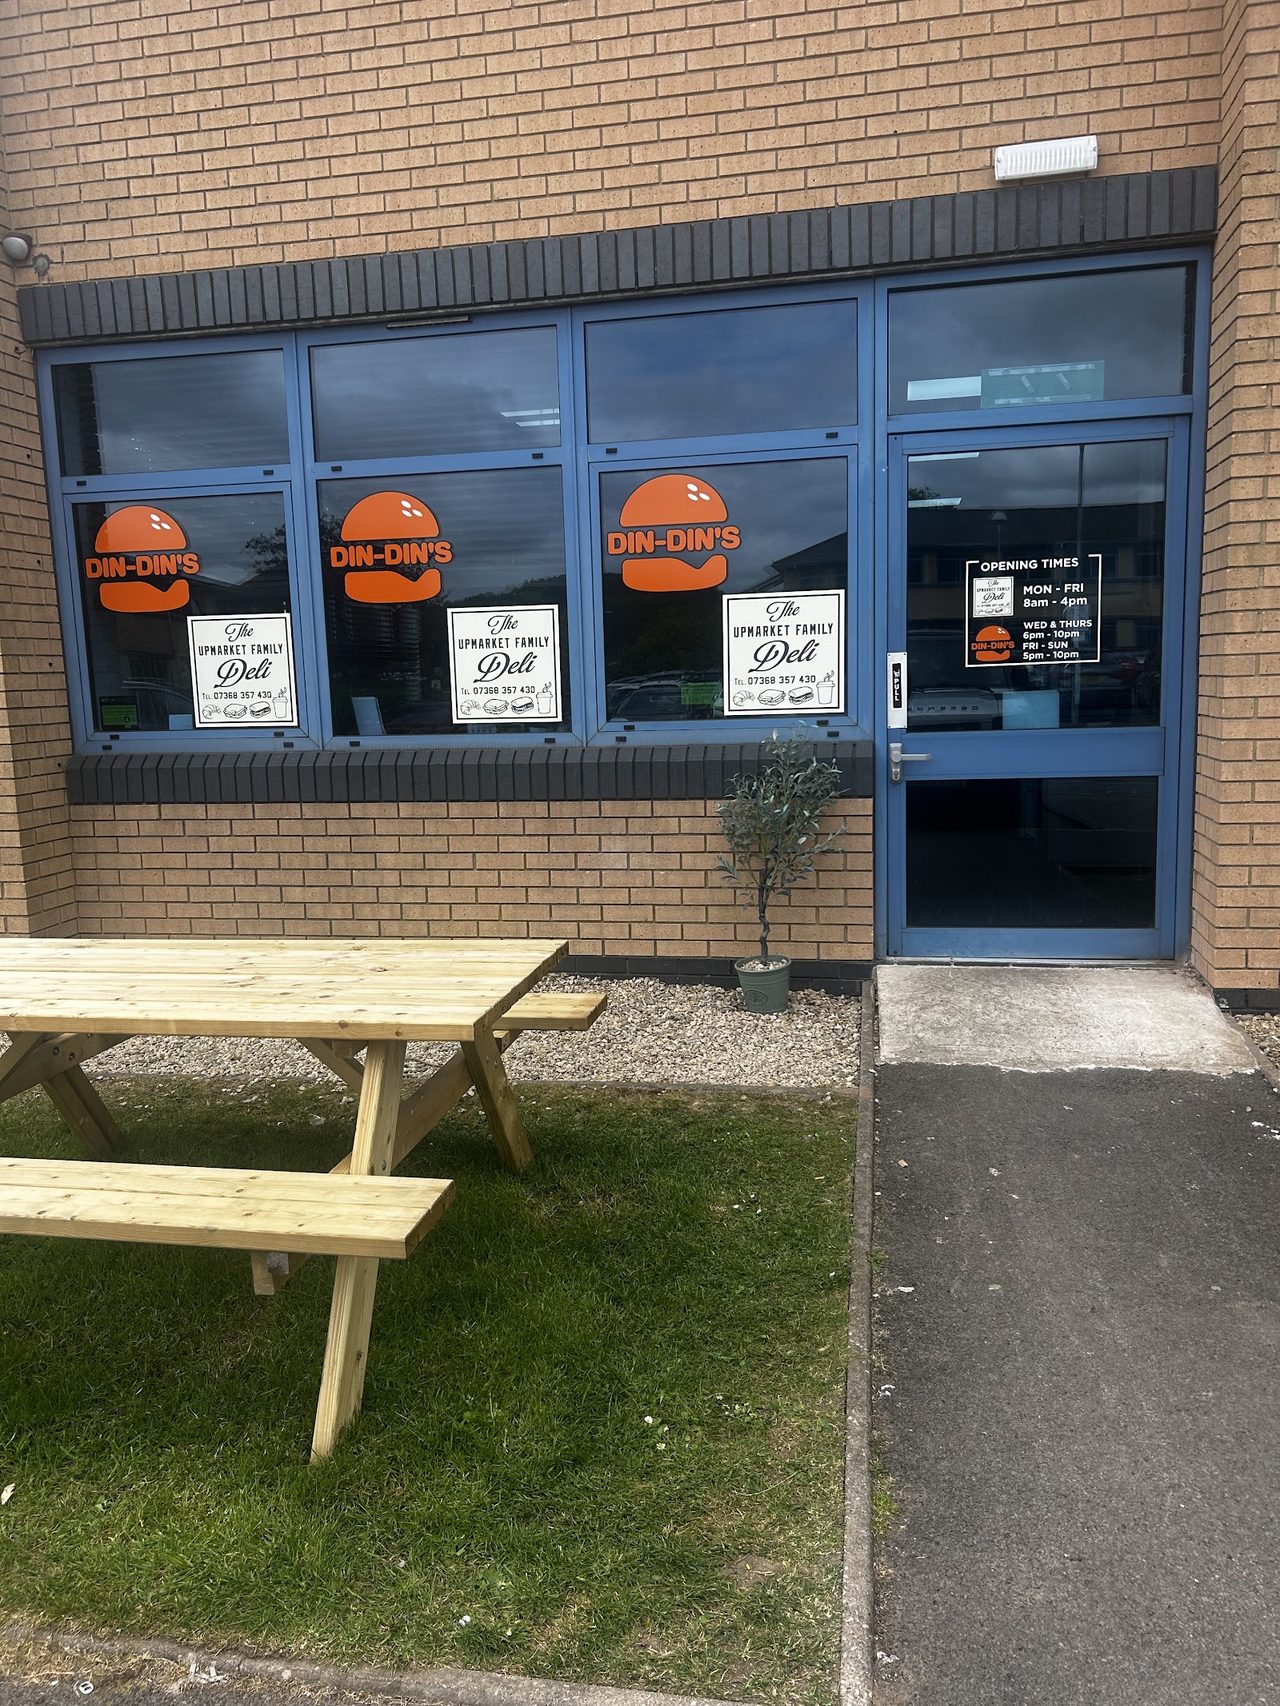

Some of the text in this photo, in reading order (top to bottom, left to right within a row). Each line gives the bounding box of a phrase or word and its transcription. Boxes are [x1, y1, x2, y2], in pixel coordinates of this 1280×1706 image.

[607, 526, 740, 555] DIN-DIN'S
[330, 541, 452, 567] DIN-DIN'S
[85, 553, 199, 578] DIN-DIN'S
[981, 558, 1078, 571] OPENING TIMES
[1024, 585, 1052, 595] MON
[1065, 583, 1083, 593] FRI
[981, 592, 1005, 603] Deli
[1024, 599, 1048, 607] 8am
[1060, 597, 1087, 607] 4pm
[766, 601, 800, 622] The
[488, 615, 518, 635] The
[734, 623, 833, 637] UPMARKET FAMILY
[1059, 620, 1092, 628] THURS
[225, 623, 253, 642] The
[1023, 632, 1044, 640] 6pm
[1054, 630, 1079, 639] 10pm
[459, 637, 549, 649] UPMARKET FAMILY
[971, 641, 1015, 651] DIN-DIN'S
[1048, 641, 1068, 649] SUN
[199, 644, 282, 656] UPMARKET FAMILY
[748, 639, 819, 673] Deli
[1023, 652, 1043, 660] 5pm
[1053, 651, 1078, 659] 10pm
[214, 658, 272, 688] Deli
[473, 652, 537, 683] Deli
[748, 677, 775, 685] 07368
[799, 675, 815, 683] 430
